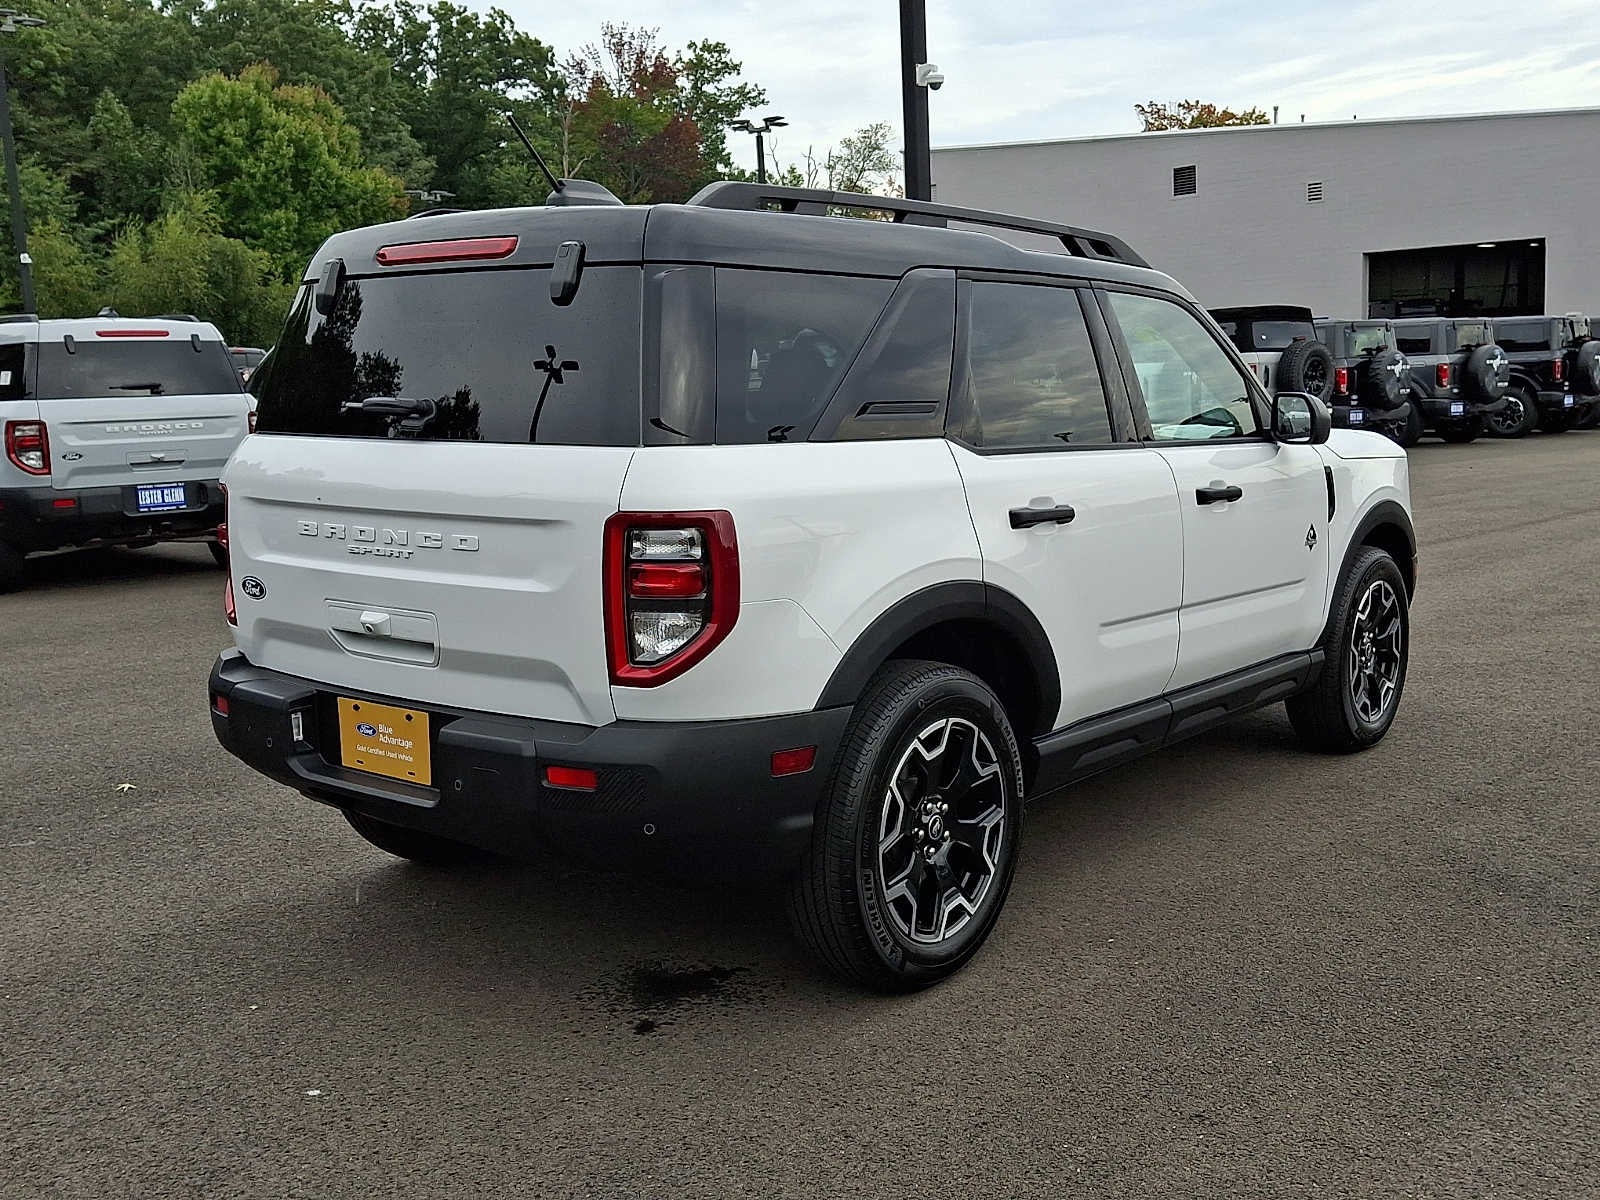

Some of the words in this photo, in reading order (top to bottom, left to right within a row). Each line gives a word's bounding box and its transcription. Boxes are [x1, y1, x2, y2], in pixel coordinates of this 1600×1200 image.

[106, 422, 203, 433] BRONCO
[138, 489, 162, 504] LESTER
[163, 487, 185, 502] GLENN
[296, 519, 480, 552] BRONCO
[346, 544, 416, 559] SPORT
[244, 579, 262, 597] Ford
[358, 723, 375, 736] Ford
[378, 724, 393, 734] Blue
[378, 734, 413, 749] Advantage
[356, 744, 367, 753] Gold
[367, 747, 385, 756] Certified
[385, 750, 398, 759] Used
[398, 753, 413, 762] Vehicle
[1004, 725, 1023, 793] MICHELIN
[863, 871, 893, 948] MICHELIN
